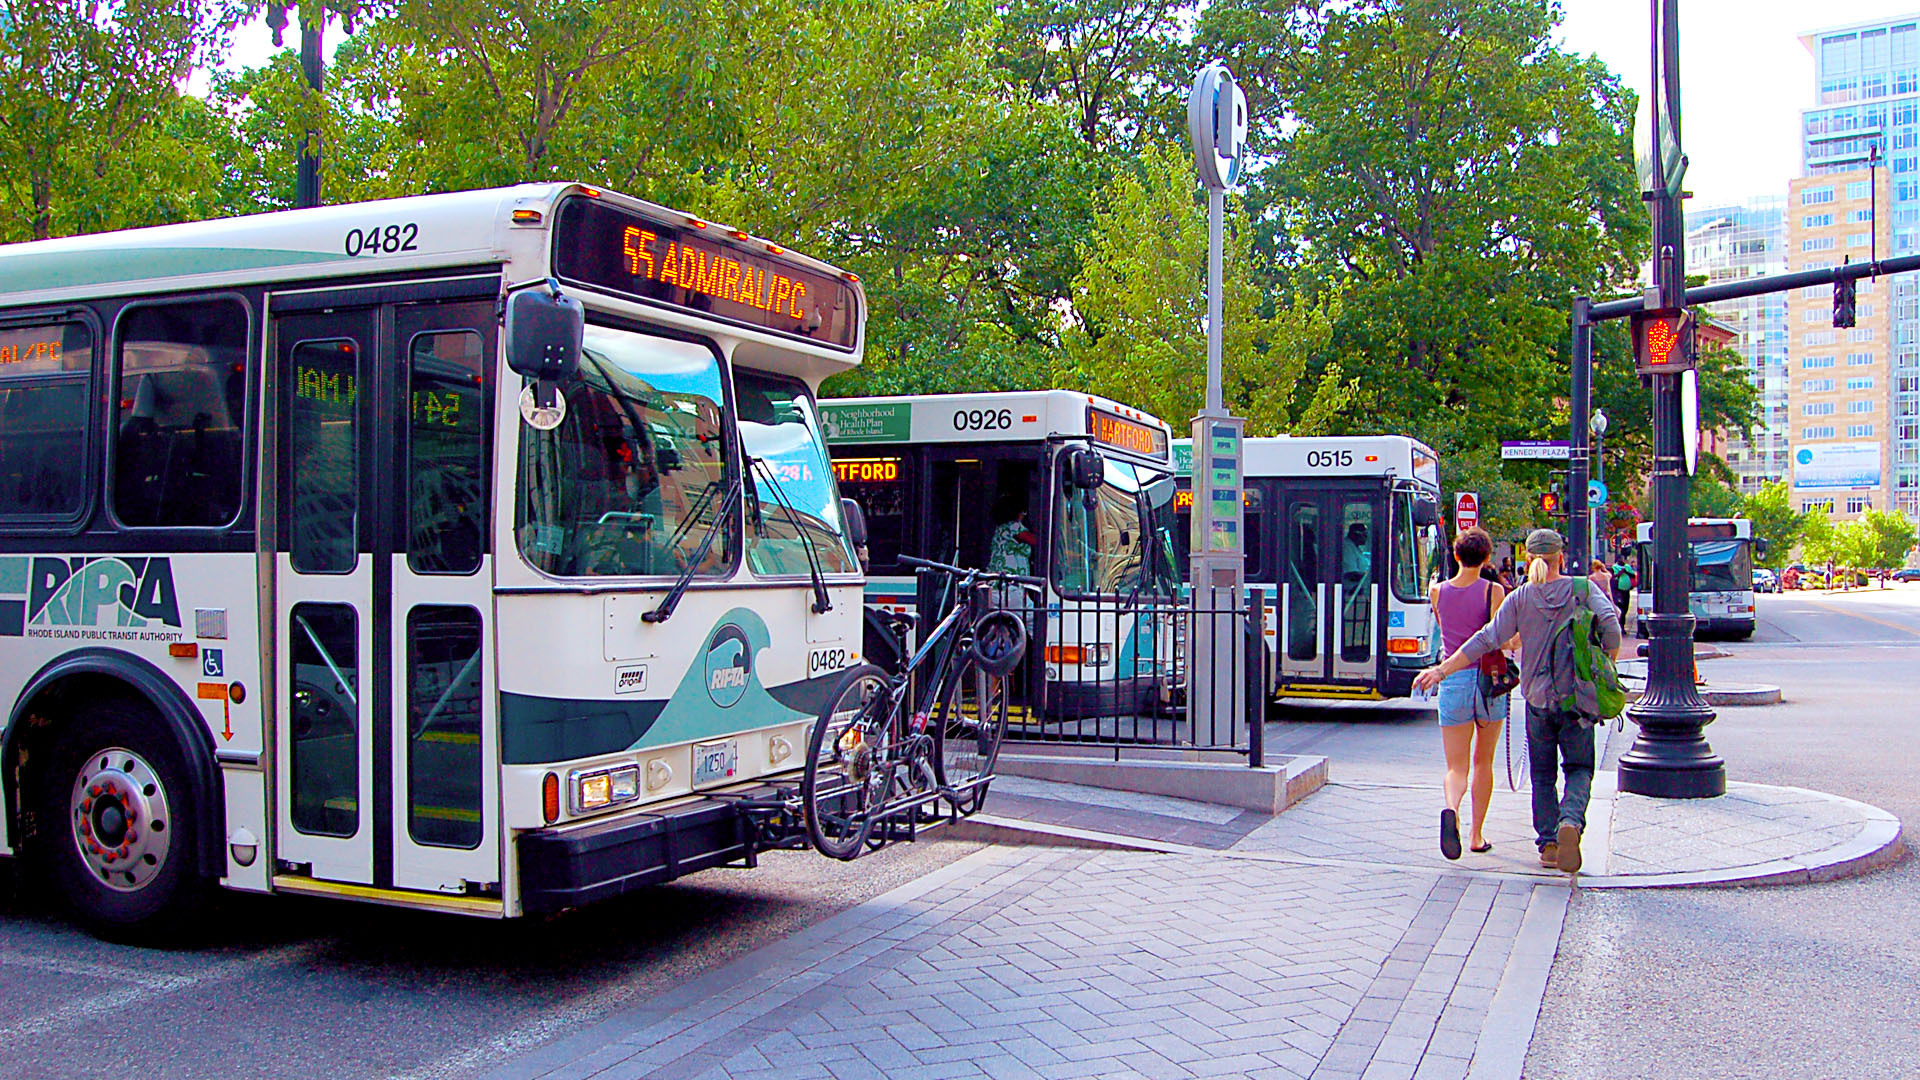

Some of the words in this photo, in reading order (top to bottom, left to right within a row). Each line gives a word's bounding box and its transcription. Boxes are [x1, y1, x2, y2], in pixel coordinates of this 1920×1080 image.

[345, 223, 418, 257] 0482
[841, 407, 895, 420] Neighborhood
[841, 418, 865, 429] Health
[867, 418, 883, 428] Plan
[953, 409, 1012, 431] 0926
[866, 427, 883, 435] Island
[1101, 418, 1153, 453] HARTFORD
[1307, 450, 1353, 467] 0515
[1504, 448, 1538, 456] KENNEDY
[1542, 448, 1567, 456] PLAZA
[29, 556, 183, 628] RIPTA
[28, 629, 53, 638] RHODE
[54, 630, 80, 639] ISLAND
[81, 630, 106, 640] PUBLIC
[108, 631, 138, 641] TRANSIT
[139, 632, 183, 642] AUTHORITY
[811, 648, 846, 672] 0482
[711, 666, 745, 690] RIPTA
[704, 751, 725, 773] 1250
